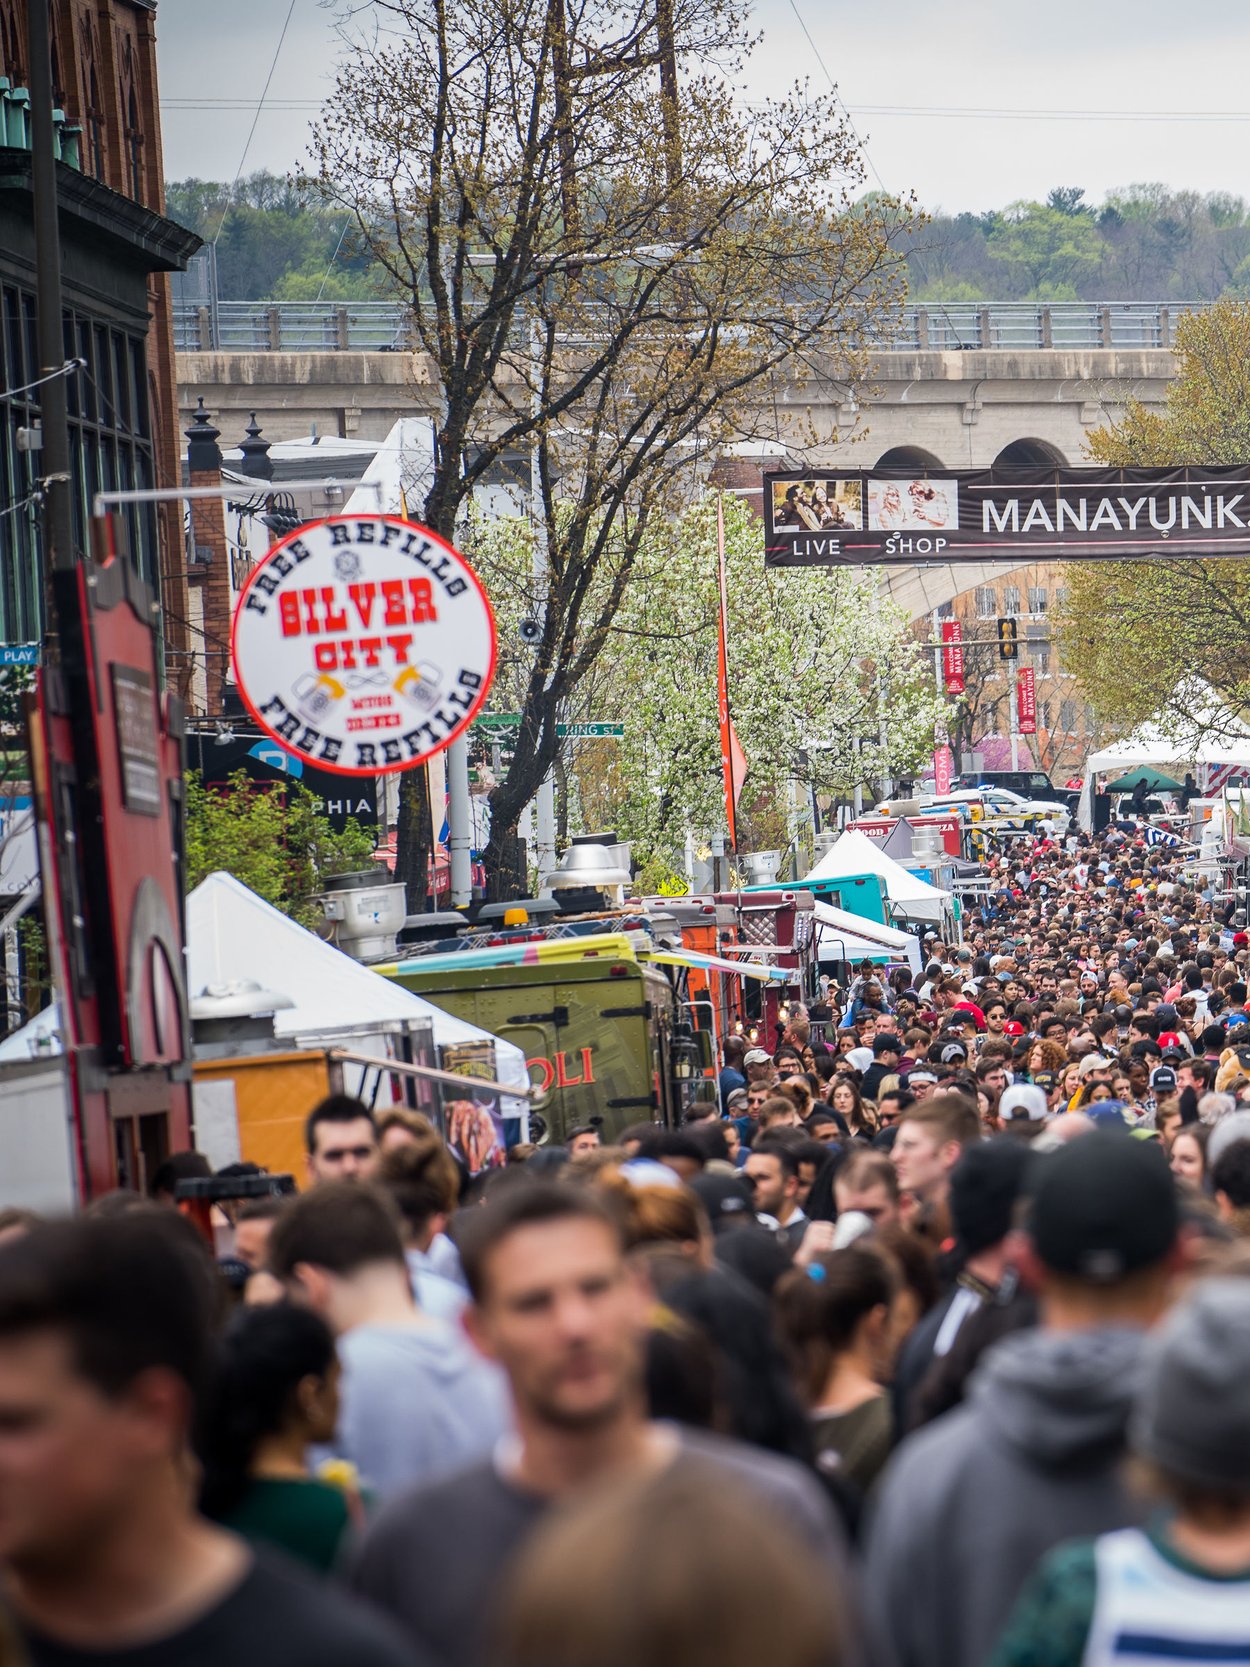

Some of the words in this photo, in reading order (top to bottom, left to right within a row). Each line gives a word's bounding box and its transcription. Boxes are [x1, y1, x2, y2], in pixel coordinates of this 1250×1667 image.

[246, 539, 311, 616] FREE
[330, 521, 468, 598] REFILLS
[793, 538, 840, 556] LIVE
[885, 537, 947, 555] SHOP
[278, 577, 438, 637] SILVER
[4, 651, 33, 662] PLAY
[314, 633, 414, 672] CITY
[953, 623, 962, 674] MANAUNK
[1026, 669, 1035, 716] MANAYUNK
[260, 695, 342, 763] FREE
[356, 667, 482, 769] REFILLS
[865, 828, 884, 837] OOD
